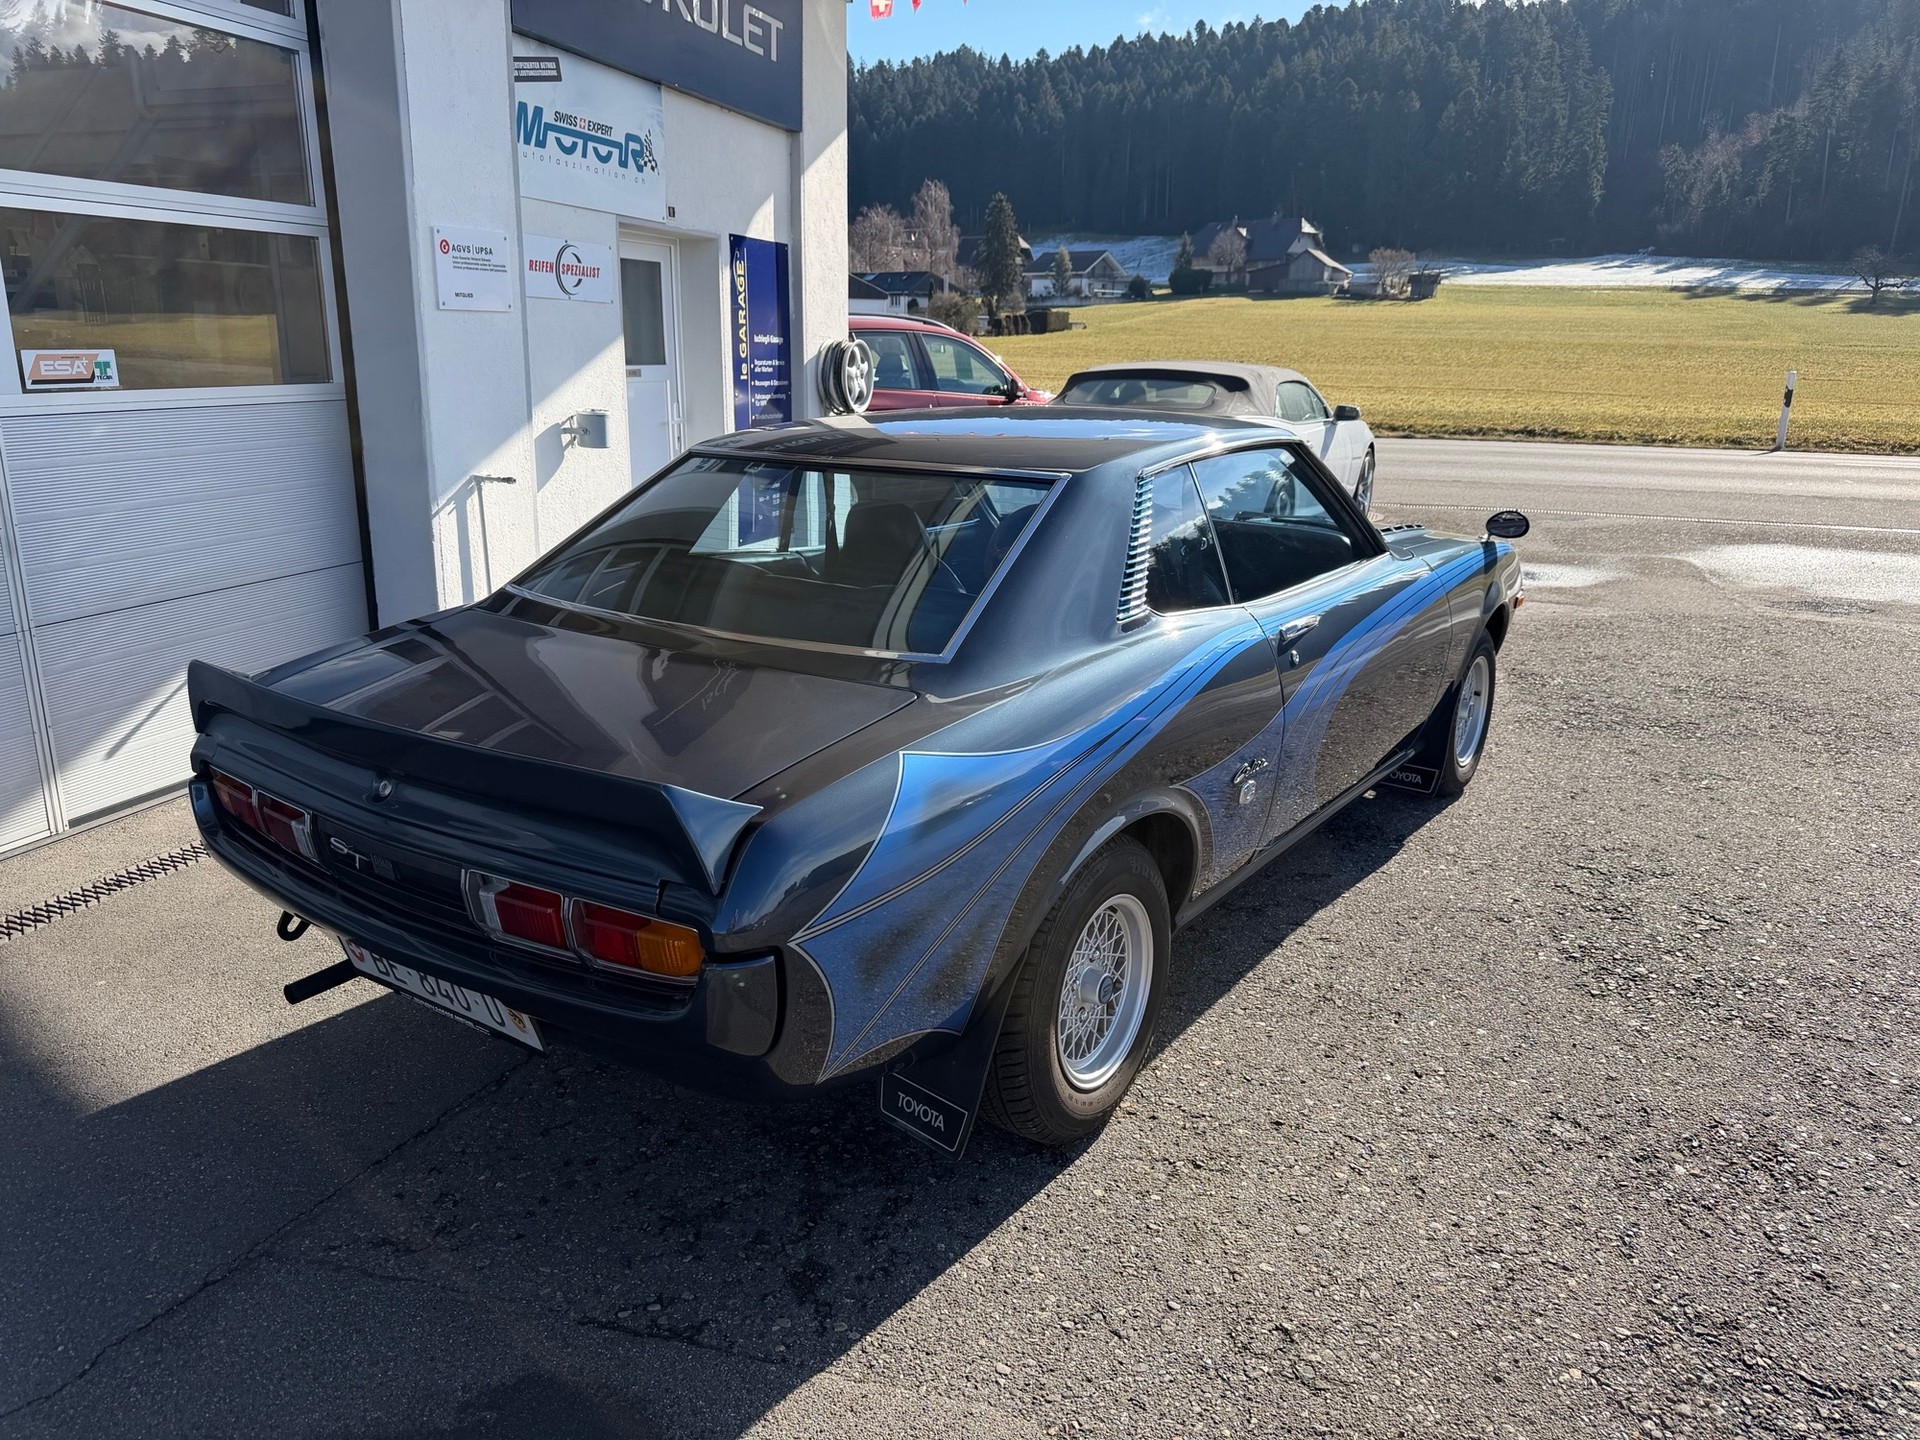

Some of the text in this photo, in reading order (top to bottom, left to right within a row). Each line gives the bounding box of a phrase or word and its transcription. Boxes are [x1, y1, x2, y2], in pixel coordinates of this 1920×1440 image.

[641, 0, 786, 63] OLET
[553, 110, 613, 137] SWISS EXPERT
[522, 151, 646, 185] utofaszination.ch
[451, 244, 493, 256] AGVS UPSA
[528, 259, 600, 279] REIFEN SPEZIALIST
[736, 259, 748, 380] le GARAGE
[39, 360, 88, 375] ESA
[1389, 770, 1422, 784] OYOTA
[897, 1091, 945, 1132] TOYOTA
